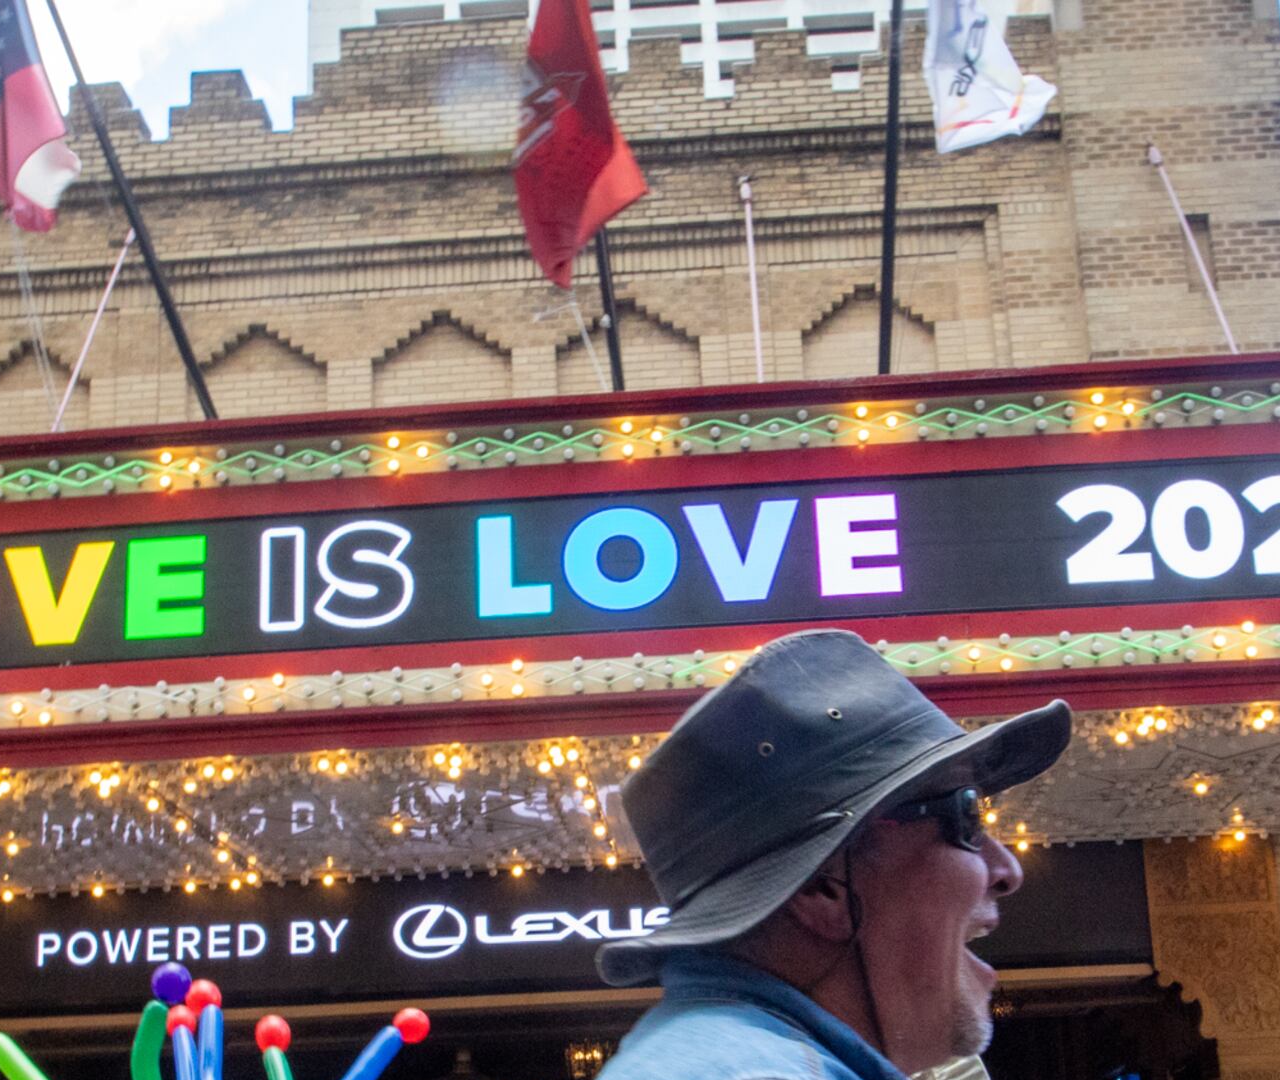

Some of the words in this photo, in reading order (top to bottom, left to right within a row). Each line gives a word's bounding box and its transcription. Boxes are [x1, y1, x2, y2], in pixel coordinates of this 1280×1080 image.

[260, 520, 414, 632] IS
[475, 493, 902, 618] LOVE
[36, 922, 267, 966] POWERED
[289, 918, 349, 955] BY
